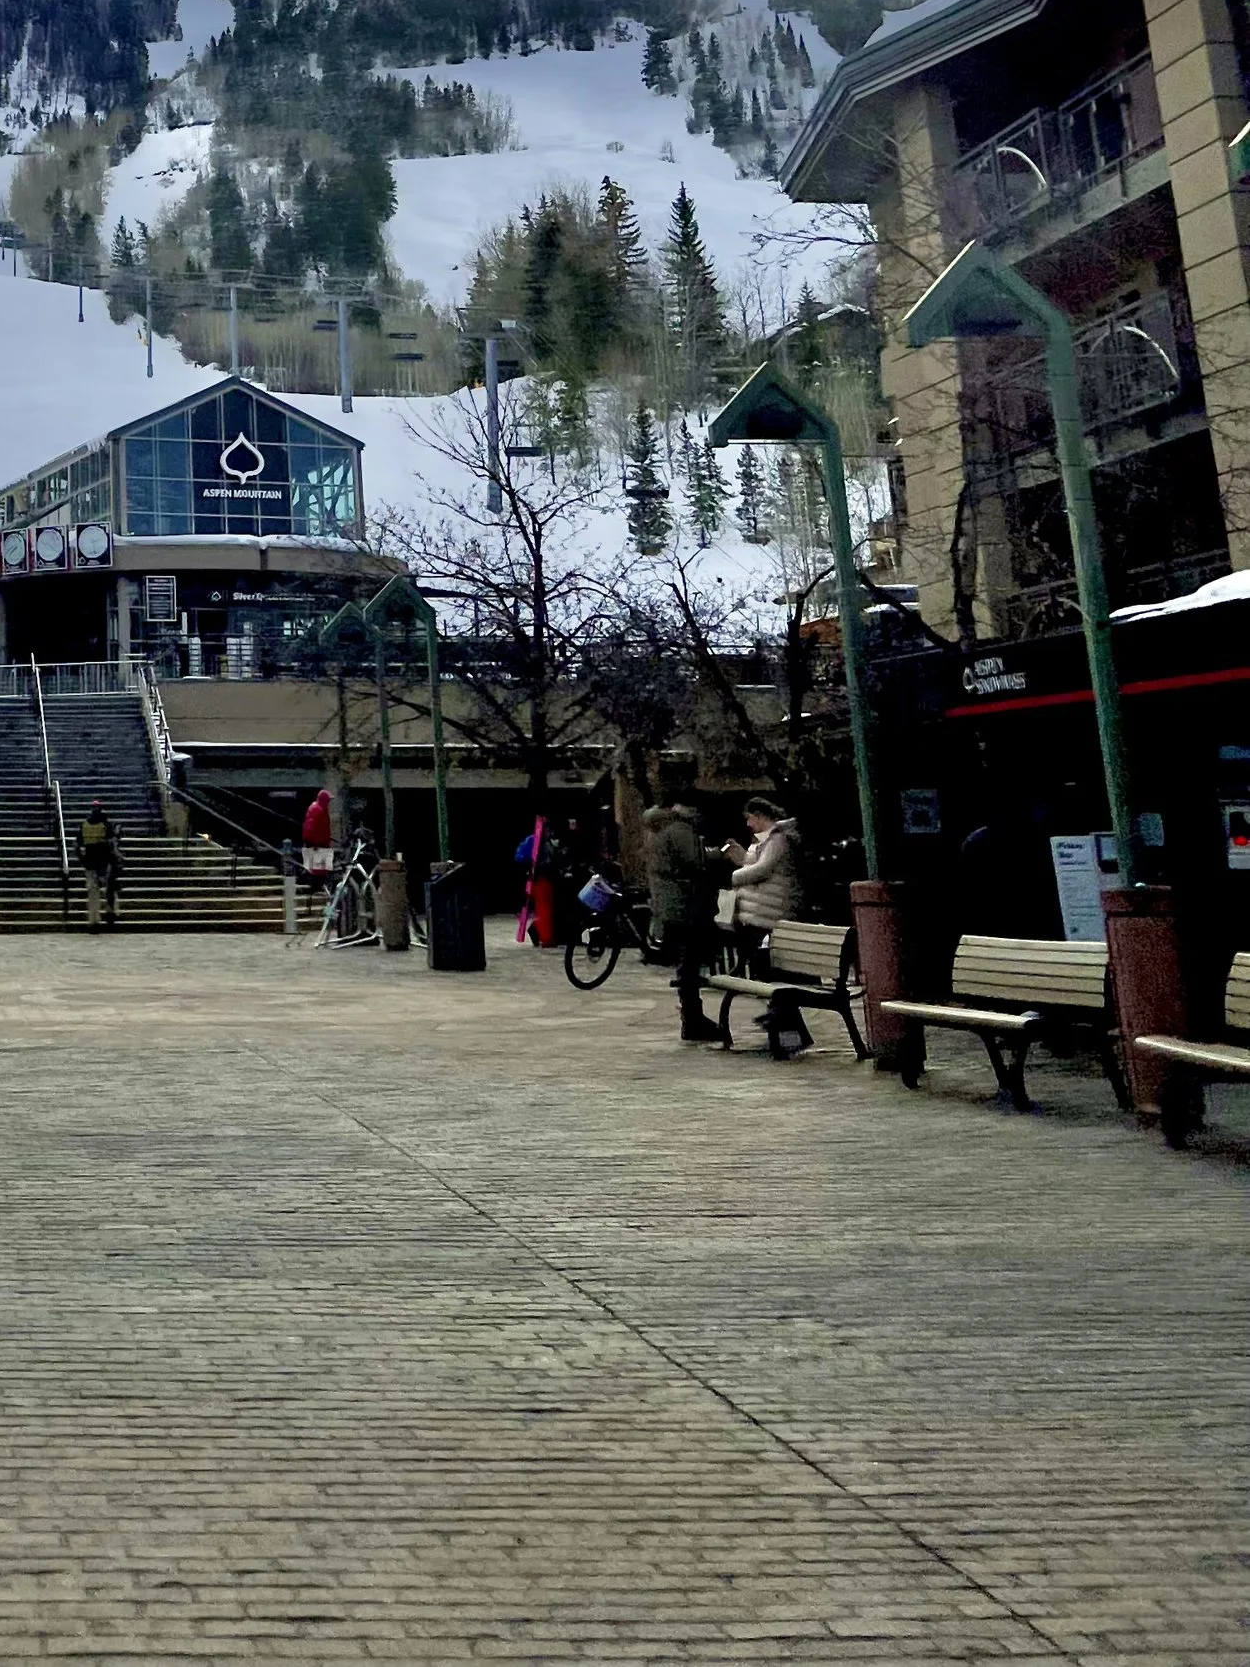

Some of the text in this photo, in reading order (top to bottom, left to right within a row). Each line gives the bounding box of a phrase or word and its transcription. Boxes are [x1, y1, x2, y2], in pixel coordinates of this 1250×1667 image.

[203, 489, 282, 499] ASPEN MOUNTAIN
[233, 591, 255, 601] Silver
